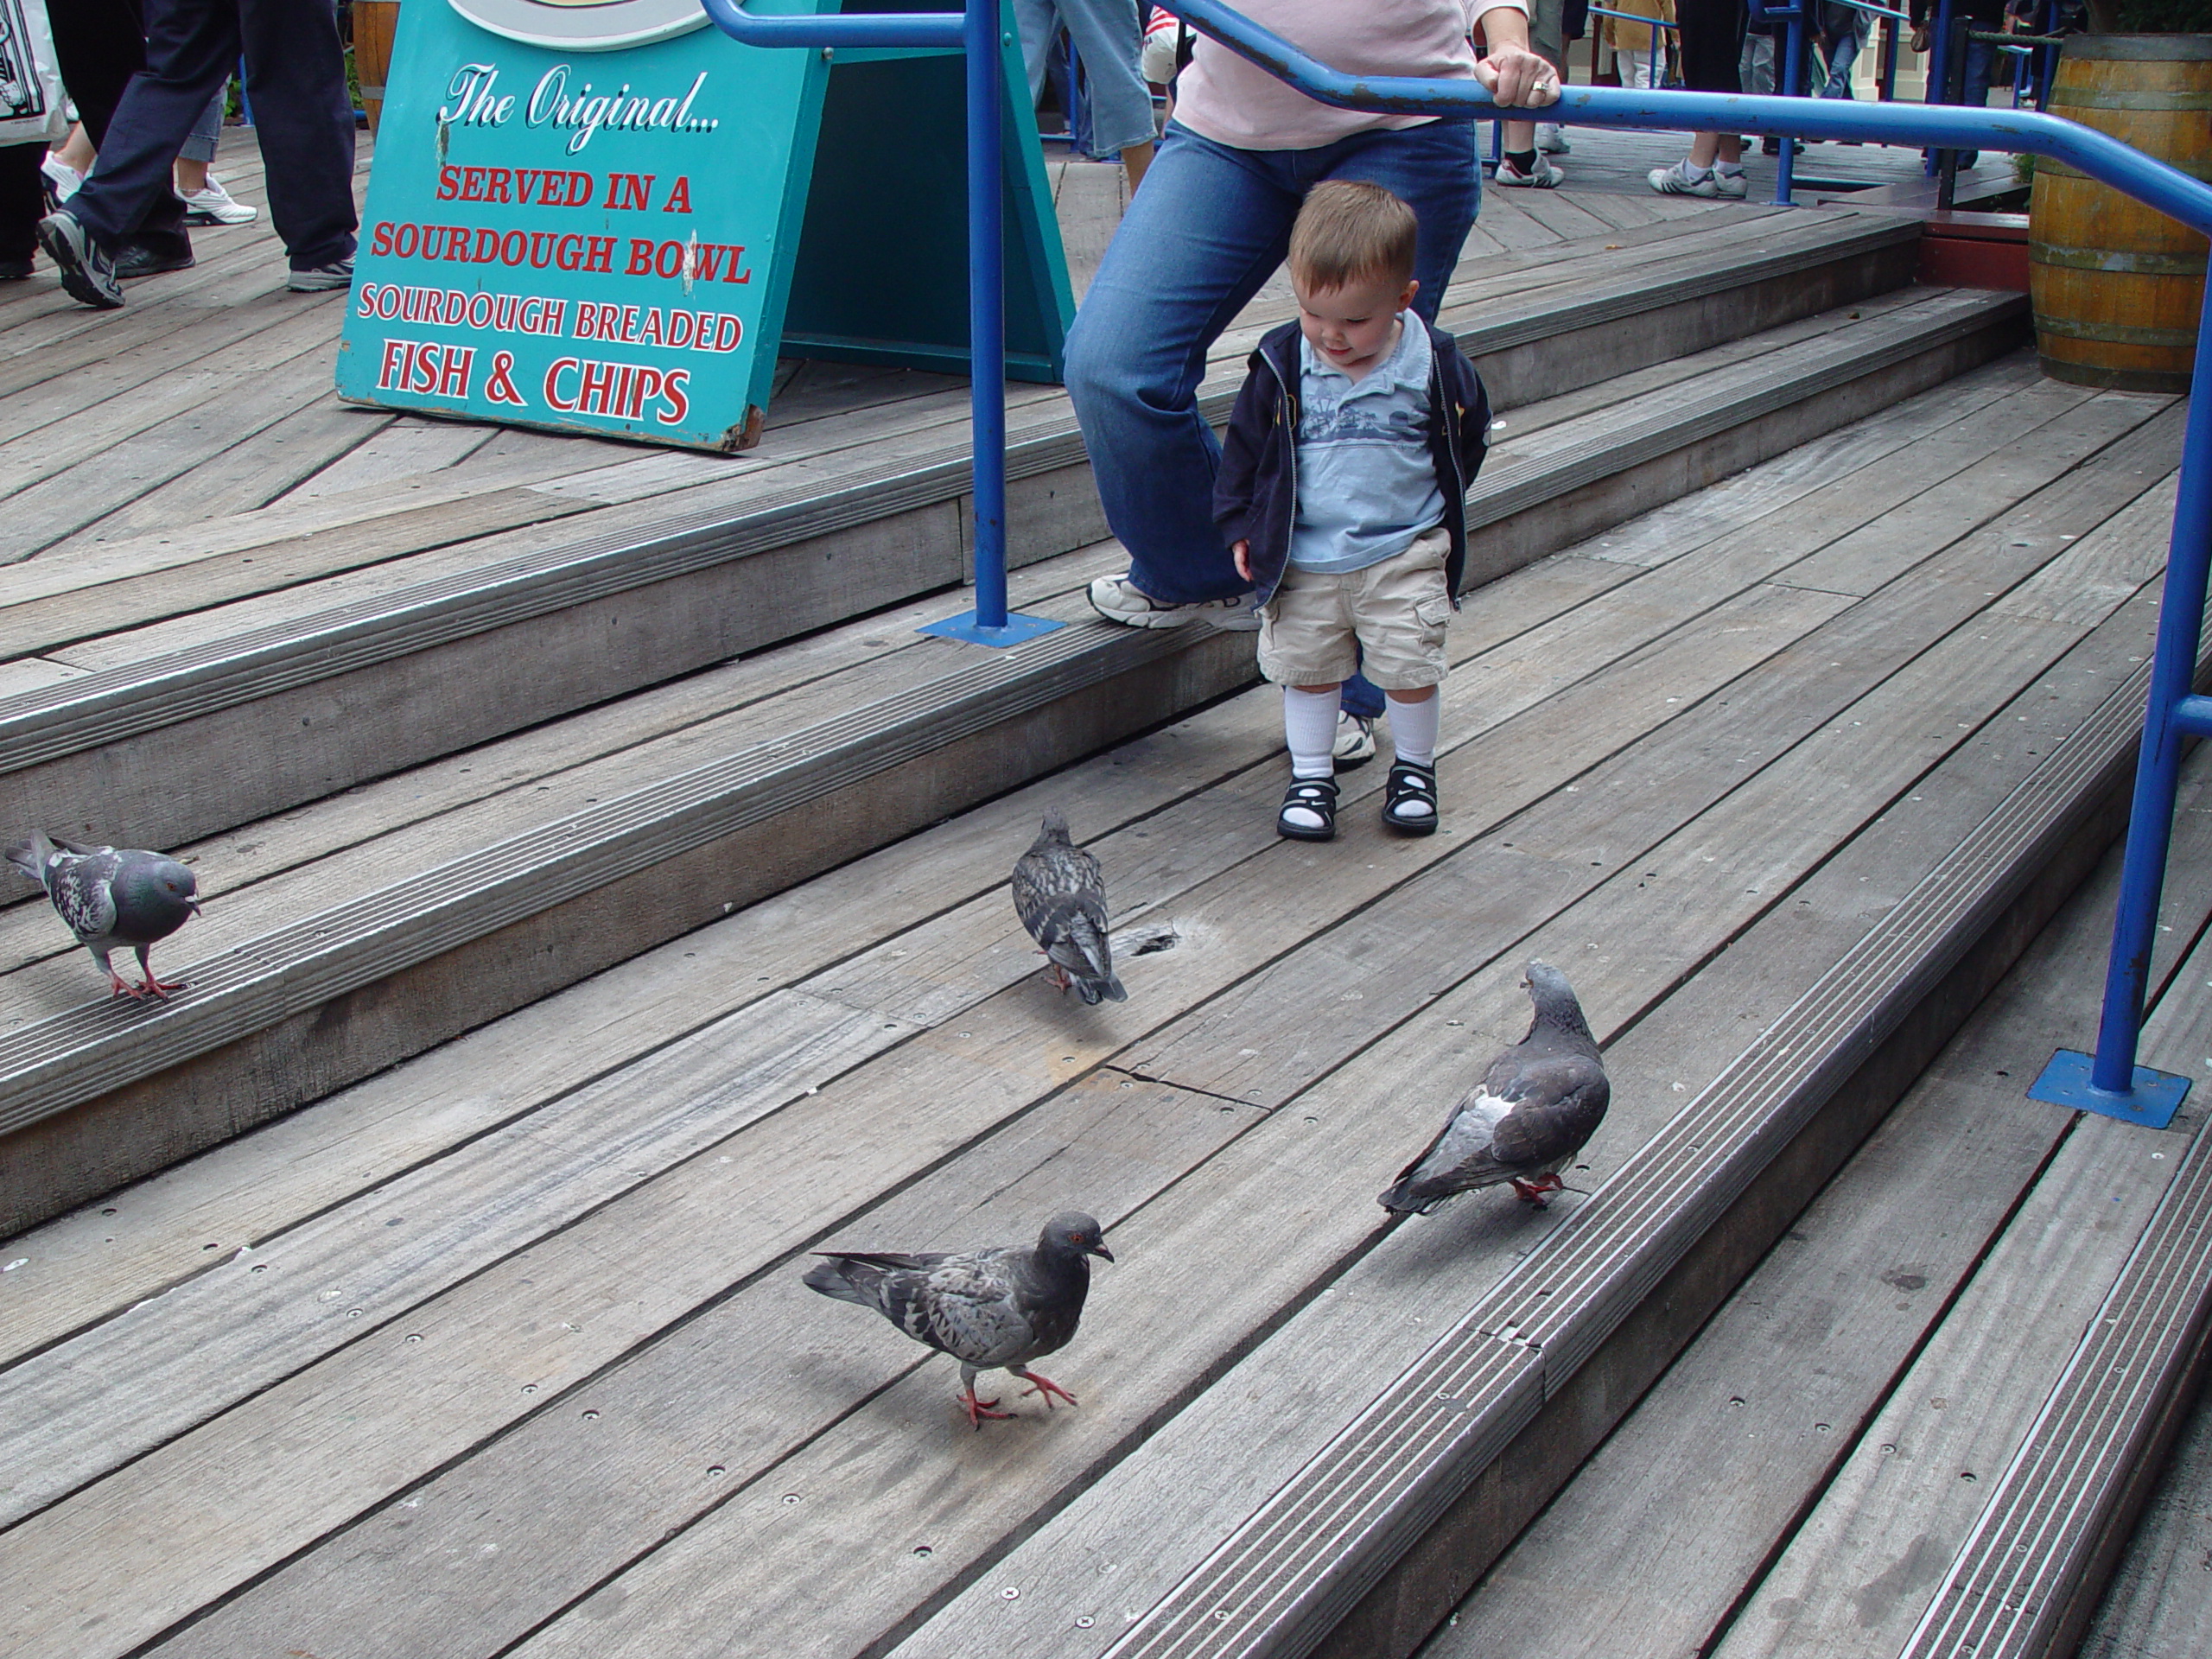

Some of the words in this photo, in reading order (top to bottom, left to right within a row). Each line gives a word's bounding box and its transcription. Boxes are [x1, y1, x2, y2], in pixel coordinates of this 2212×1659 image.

[438, 62, 516, 125] The
[525, 64, 719, 156] Original...
[436, 165, 594, 207] SERVED
[602, 172, 656, 211] IN
[662, 175, 693, 213] A
[371, 221, 619, 273] SOURDOUGH
[625, 238, 752, 285] BOWL
[357, 282, 569, 335] SOURDOUGH
[571, 301, 744, 354] BREADED
[375, 338, 479, 399] FISH
[484, 350, 529, 407] &
[543, 356, 690, 426] CHIPS
